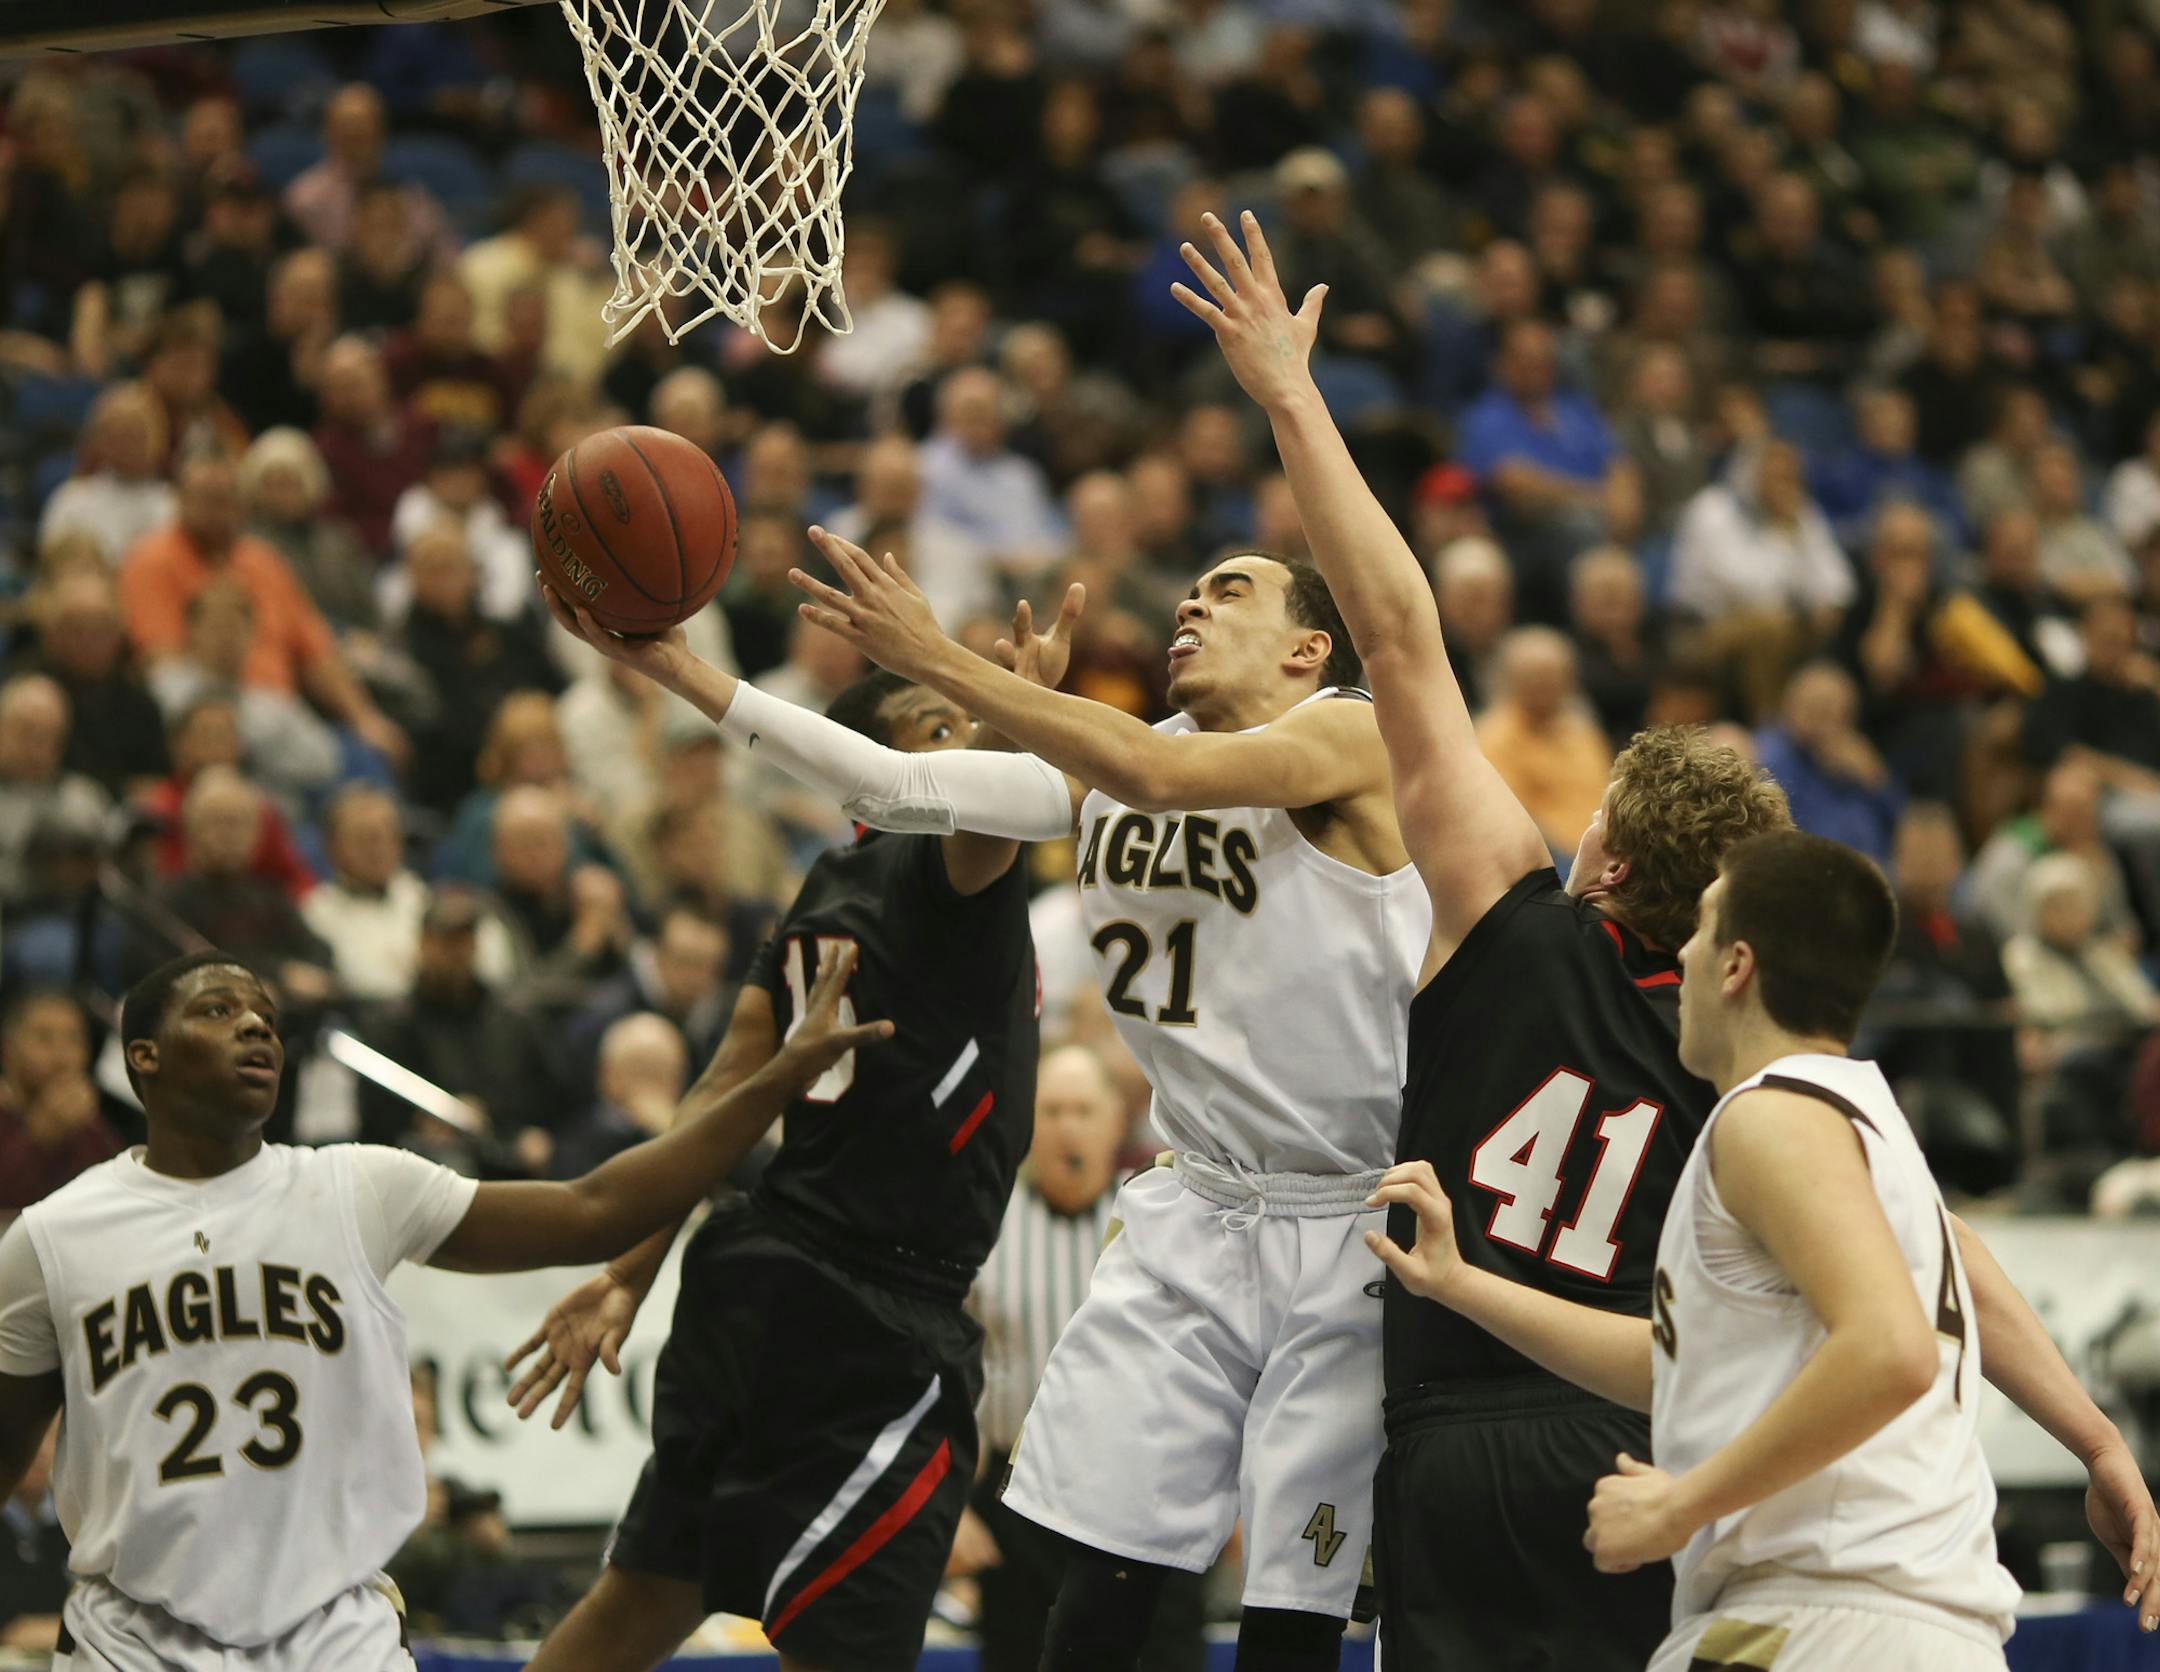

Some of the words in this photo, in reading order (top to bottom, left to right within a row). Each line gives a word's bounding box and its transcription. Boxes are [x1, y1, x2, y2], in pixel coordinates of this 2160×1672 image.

[1076, 812, 1260, 917] AGLES
[1091, 919, 1199, 1028] 21
[1469, 1066, 1664, 1282] 41
[82, 1263, 347, 1394] EAGLES
[153, 1371, 304, 1487] 23
[1301, 1503, 1348, 1567] AV
